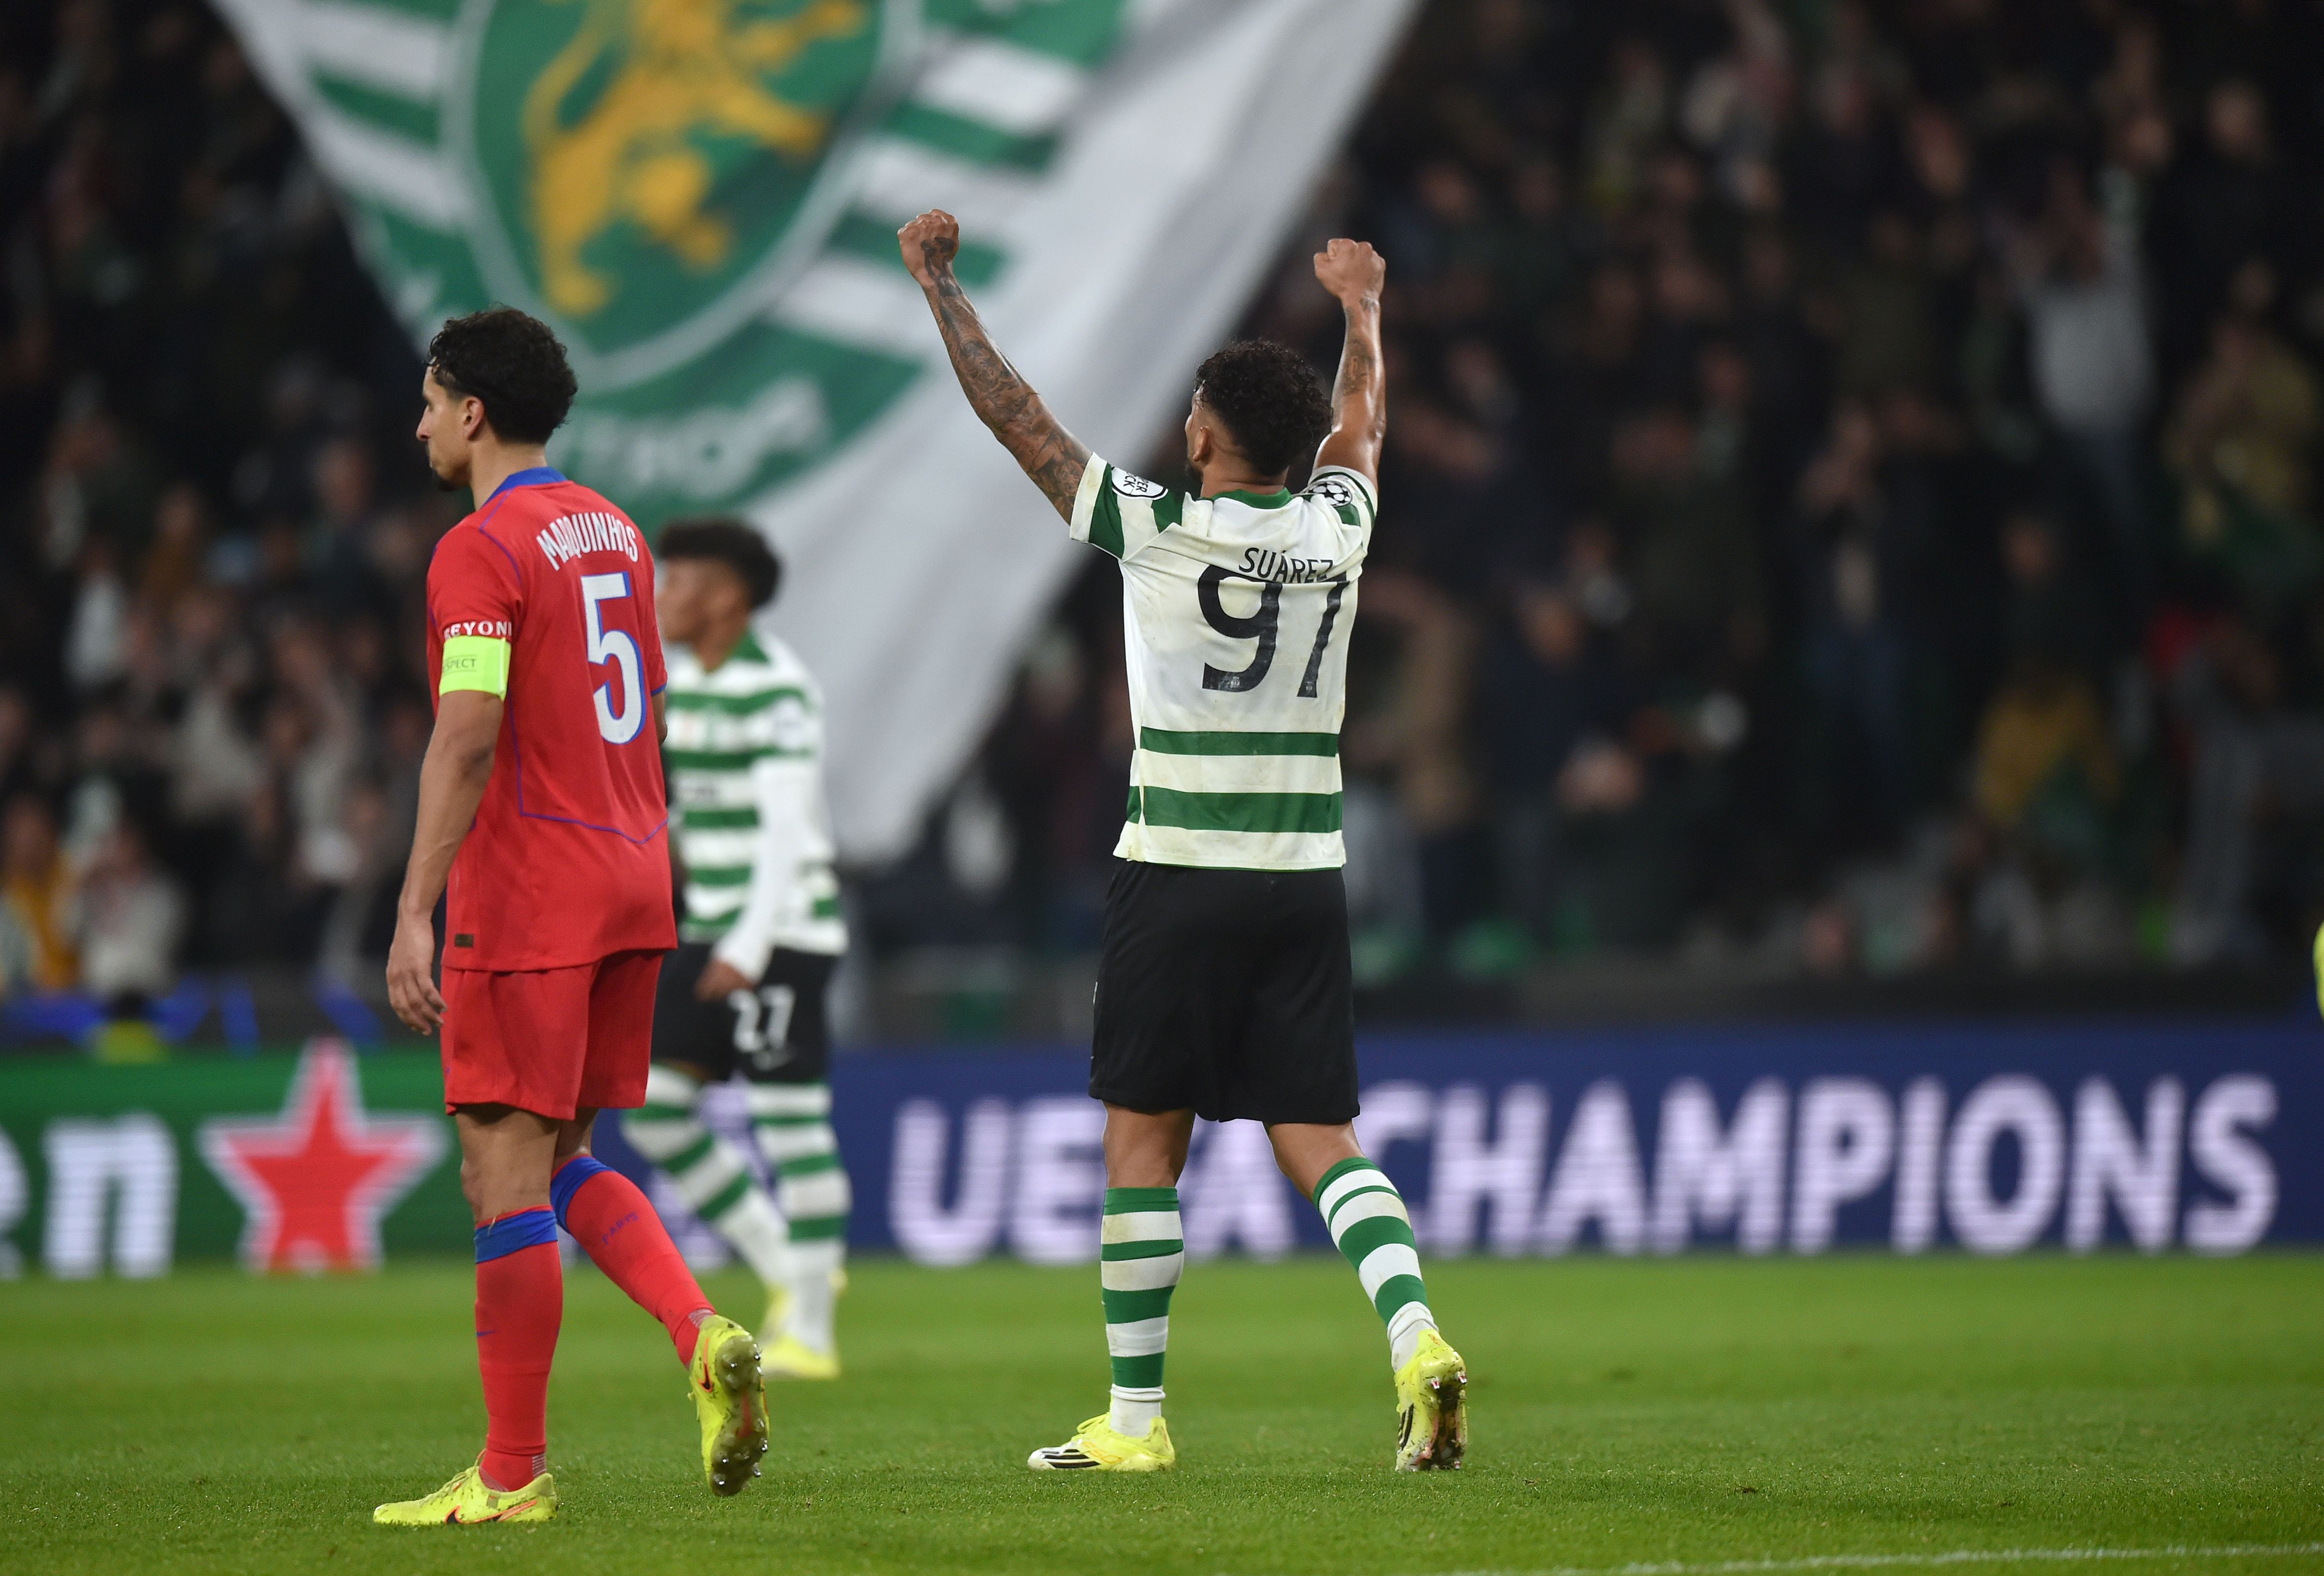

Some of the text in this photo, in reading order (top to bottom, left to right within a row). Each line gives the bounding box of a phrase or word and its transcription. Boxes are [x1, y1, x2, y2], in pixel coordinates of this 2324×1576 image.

[1197, 563, 1351, 698] 97
[1239, 547, 1333, 584] SUÁREZ
[580, 571, 647, 745] 5
[727, 984, 795, 1053] 27
[888, 1096, 1296, 1266] UEA
